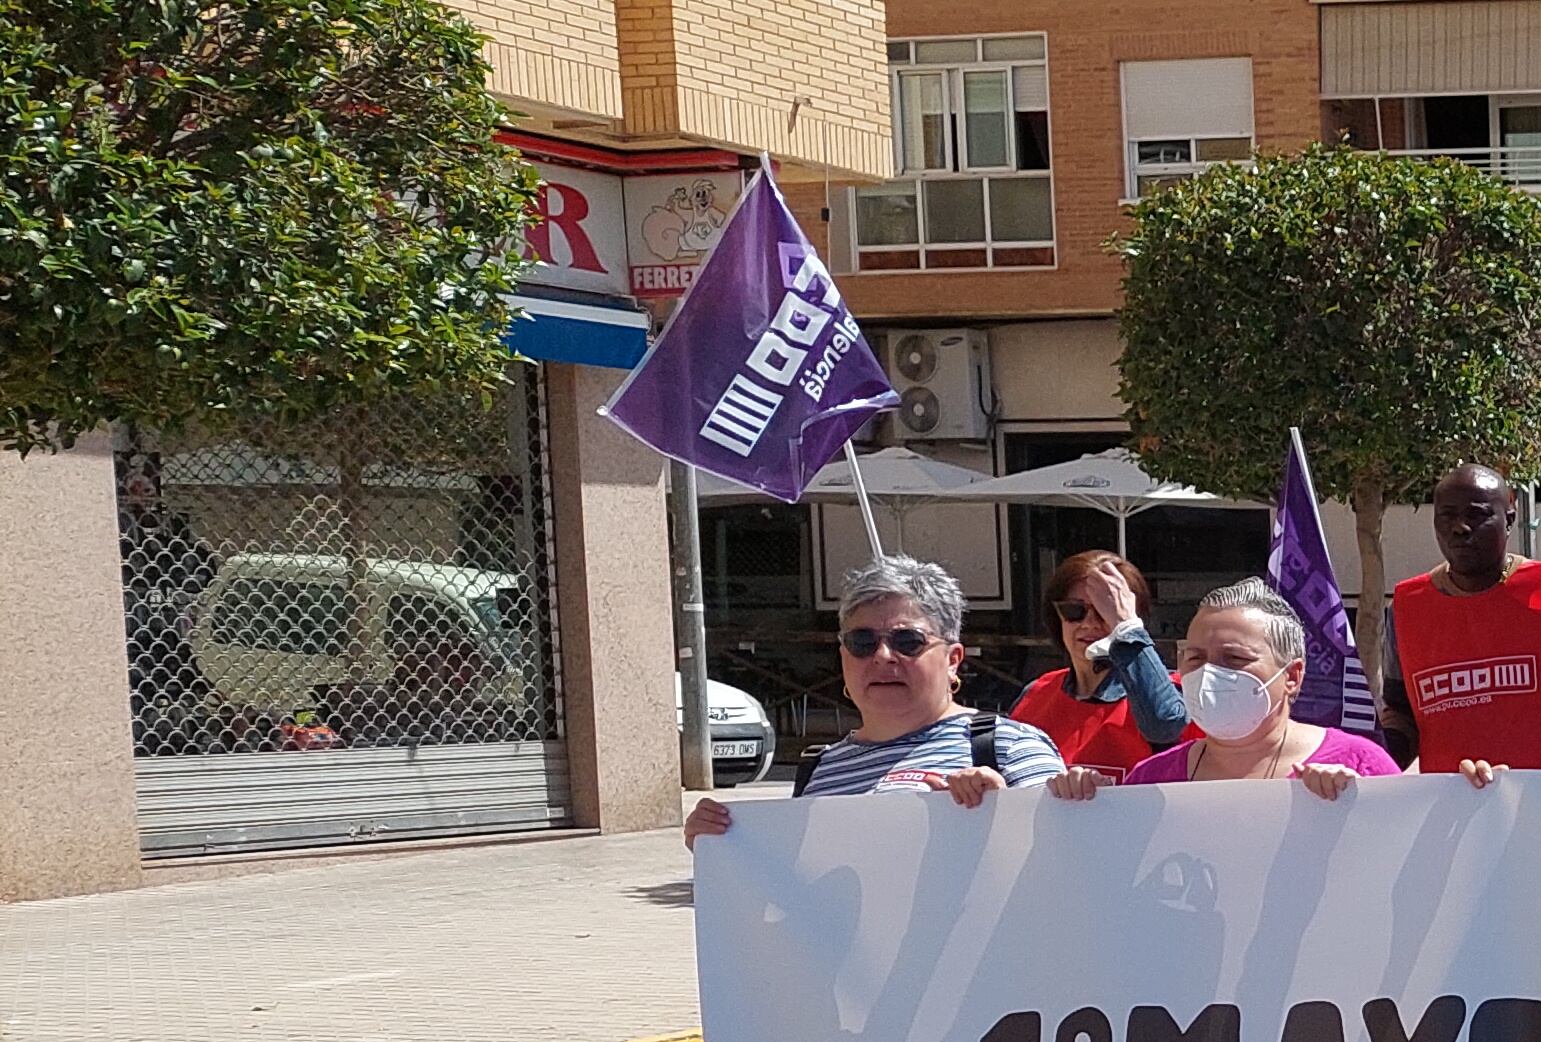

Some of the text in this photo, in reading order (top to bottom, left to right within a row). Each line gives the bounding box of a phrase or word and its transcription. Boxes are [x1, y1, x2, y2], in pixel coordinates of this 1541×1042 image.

[633, 265, 700, 290] FERRE
[1419, 667, 1491, 702] CCOO
[713, 744, 736, 756] 6373
